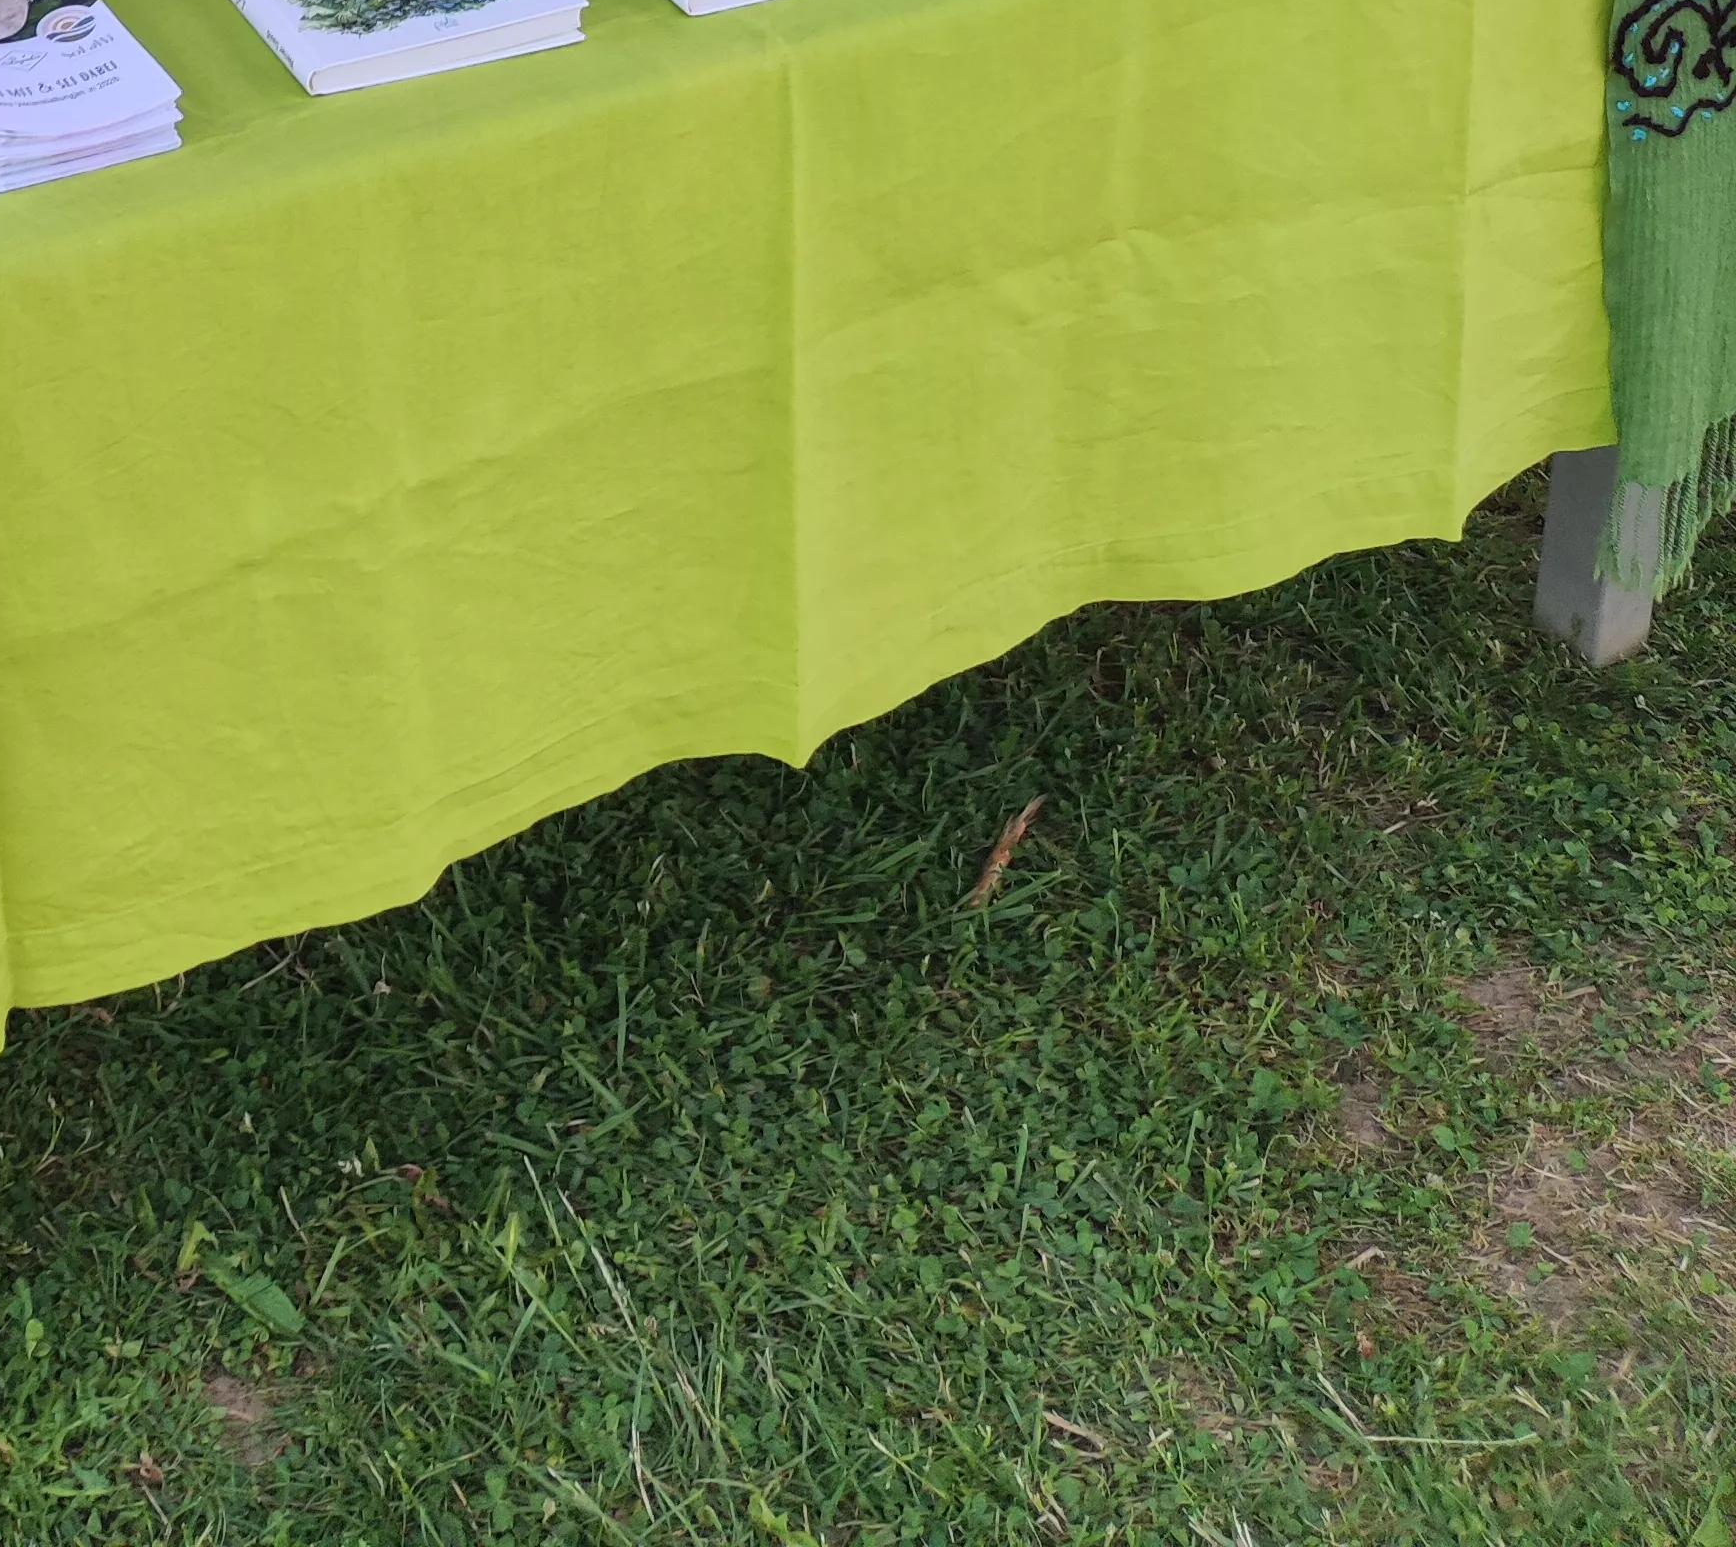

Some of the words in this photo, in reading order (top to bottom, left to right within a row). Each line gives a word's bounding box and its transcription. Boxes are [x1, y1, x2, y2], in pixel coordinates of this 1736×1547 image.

[38, 81, 54, 94] &
[55, 75, 79, 89] SEI
[78, 59, 119, 83] DABEI
